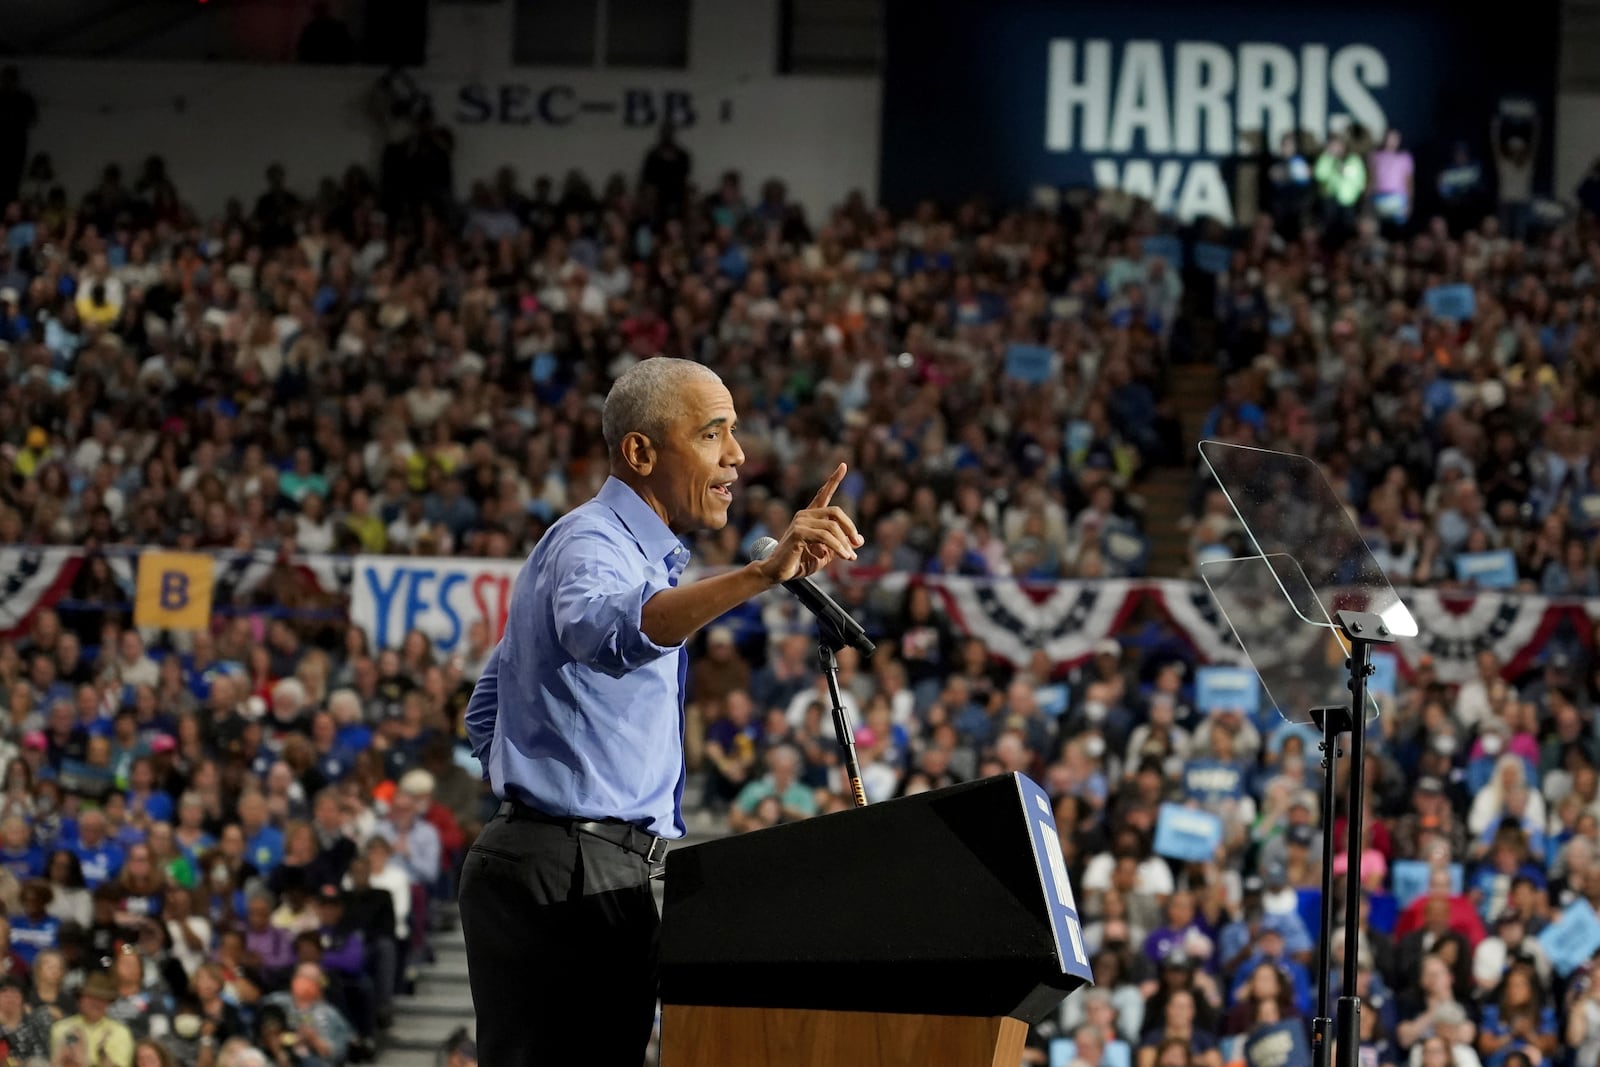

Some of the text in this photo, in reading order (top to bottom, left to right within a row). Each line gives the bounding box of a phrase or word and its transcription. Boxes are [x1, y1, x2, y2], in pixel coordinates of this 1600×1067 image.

[1045, 38, 1389, 155] HARRIS
[1092, 159, 1237, 228] WA
[159, 570, 190, 611] B
[364, 567, 468, 651] YES
